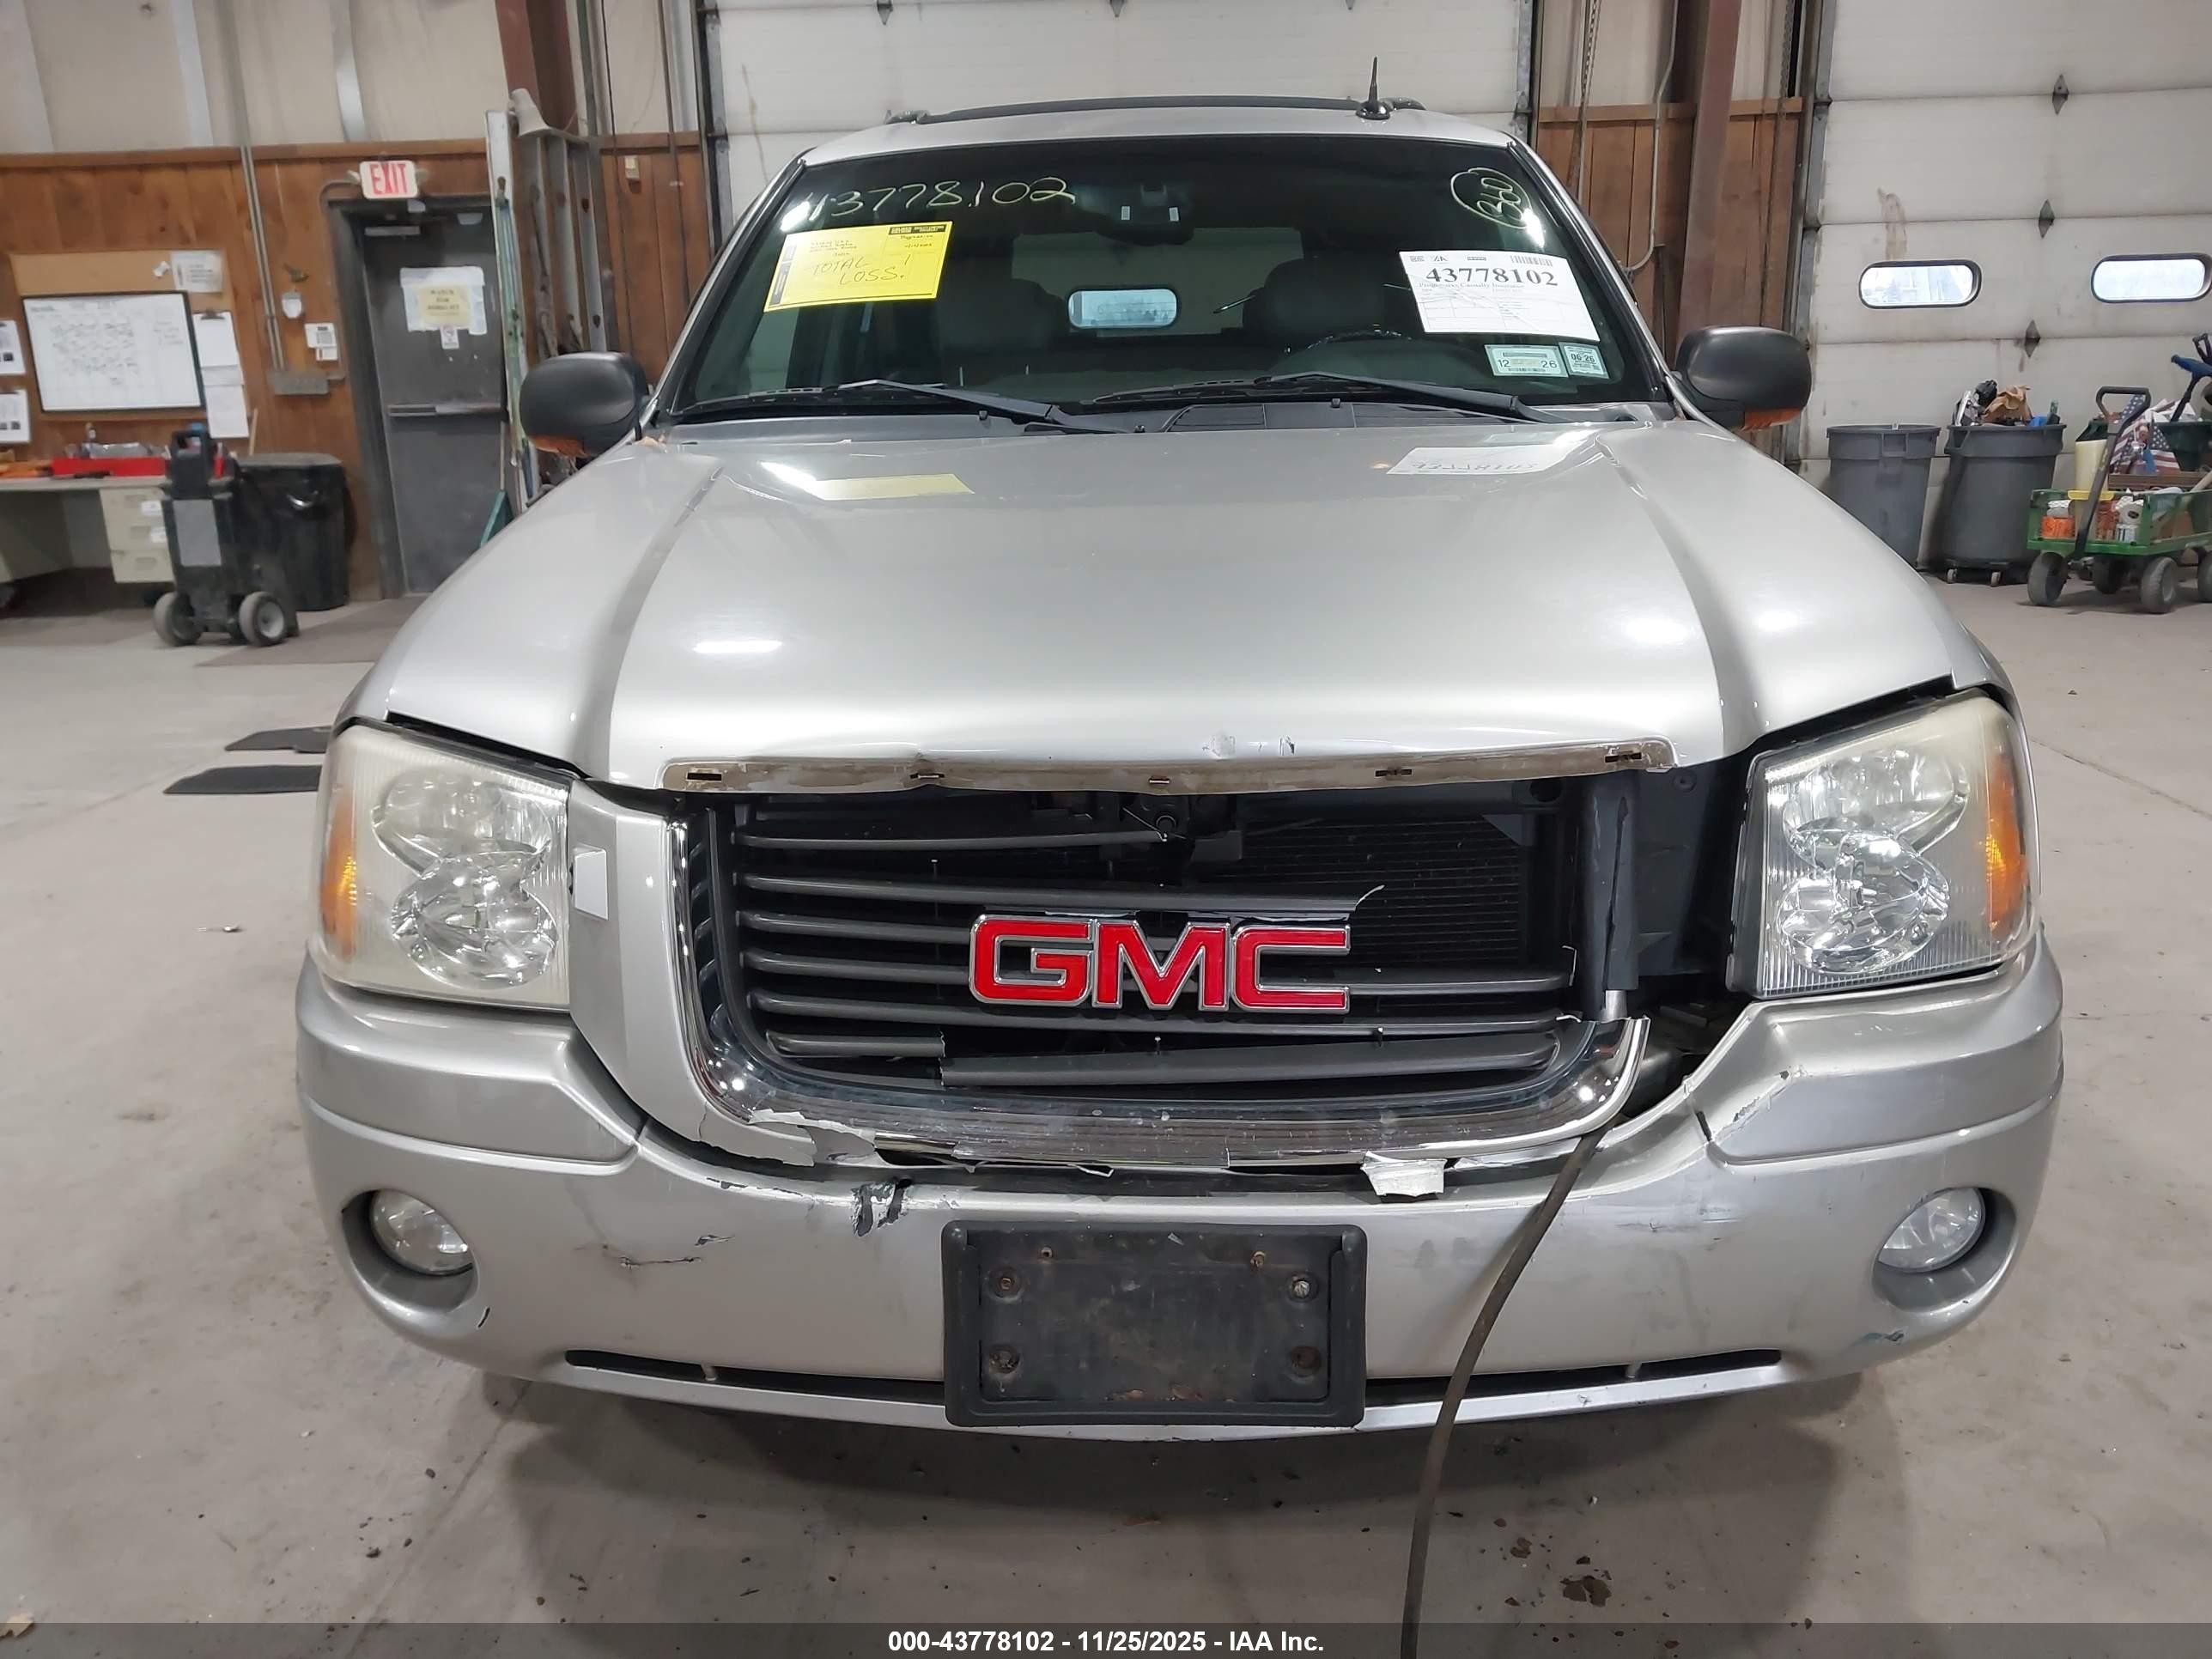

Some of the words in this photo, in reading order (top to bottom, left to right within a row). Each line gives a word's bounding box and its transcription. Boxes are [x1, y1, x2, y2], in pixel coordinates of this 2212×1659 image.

[370, 163, 407, 195] EXIT
[811, 256, 872, 276] TOTAL
[1425, 267, 1559, 287] 43778102
[1498, 359, 1511, 368] 12
[1540, 360, 1558, 368] 26
[969, 915, 1352, 1014] GMC
